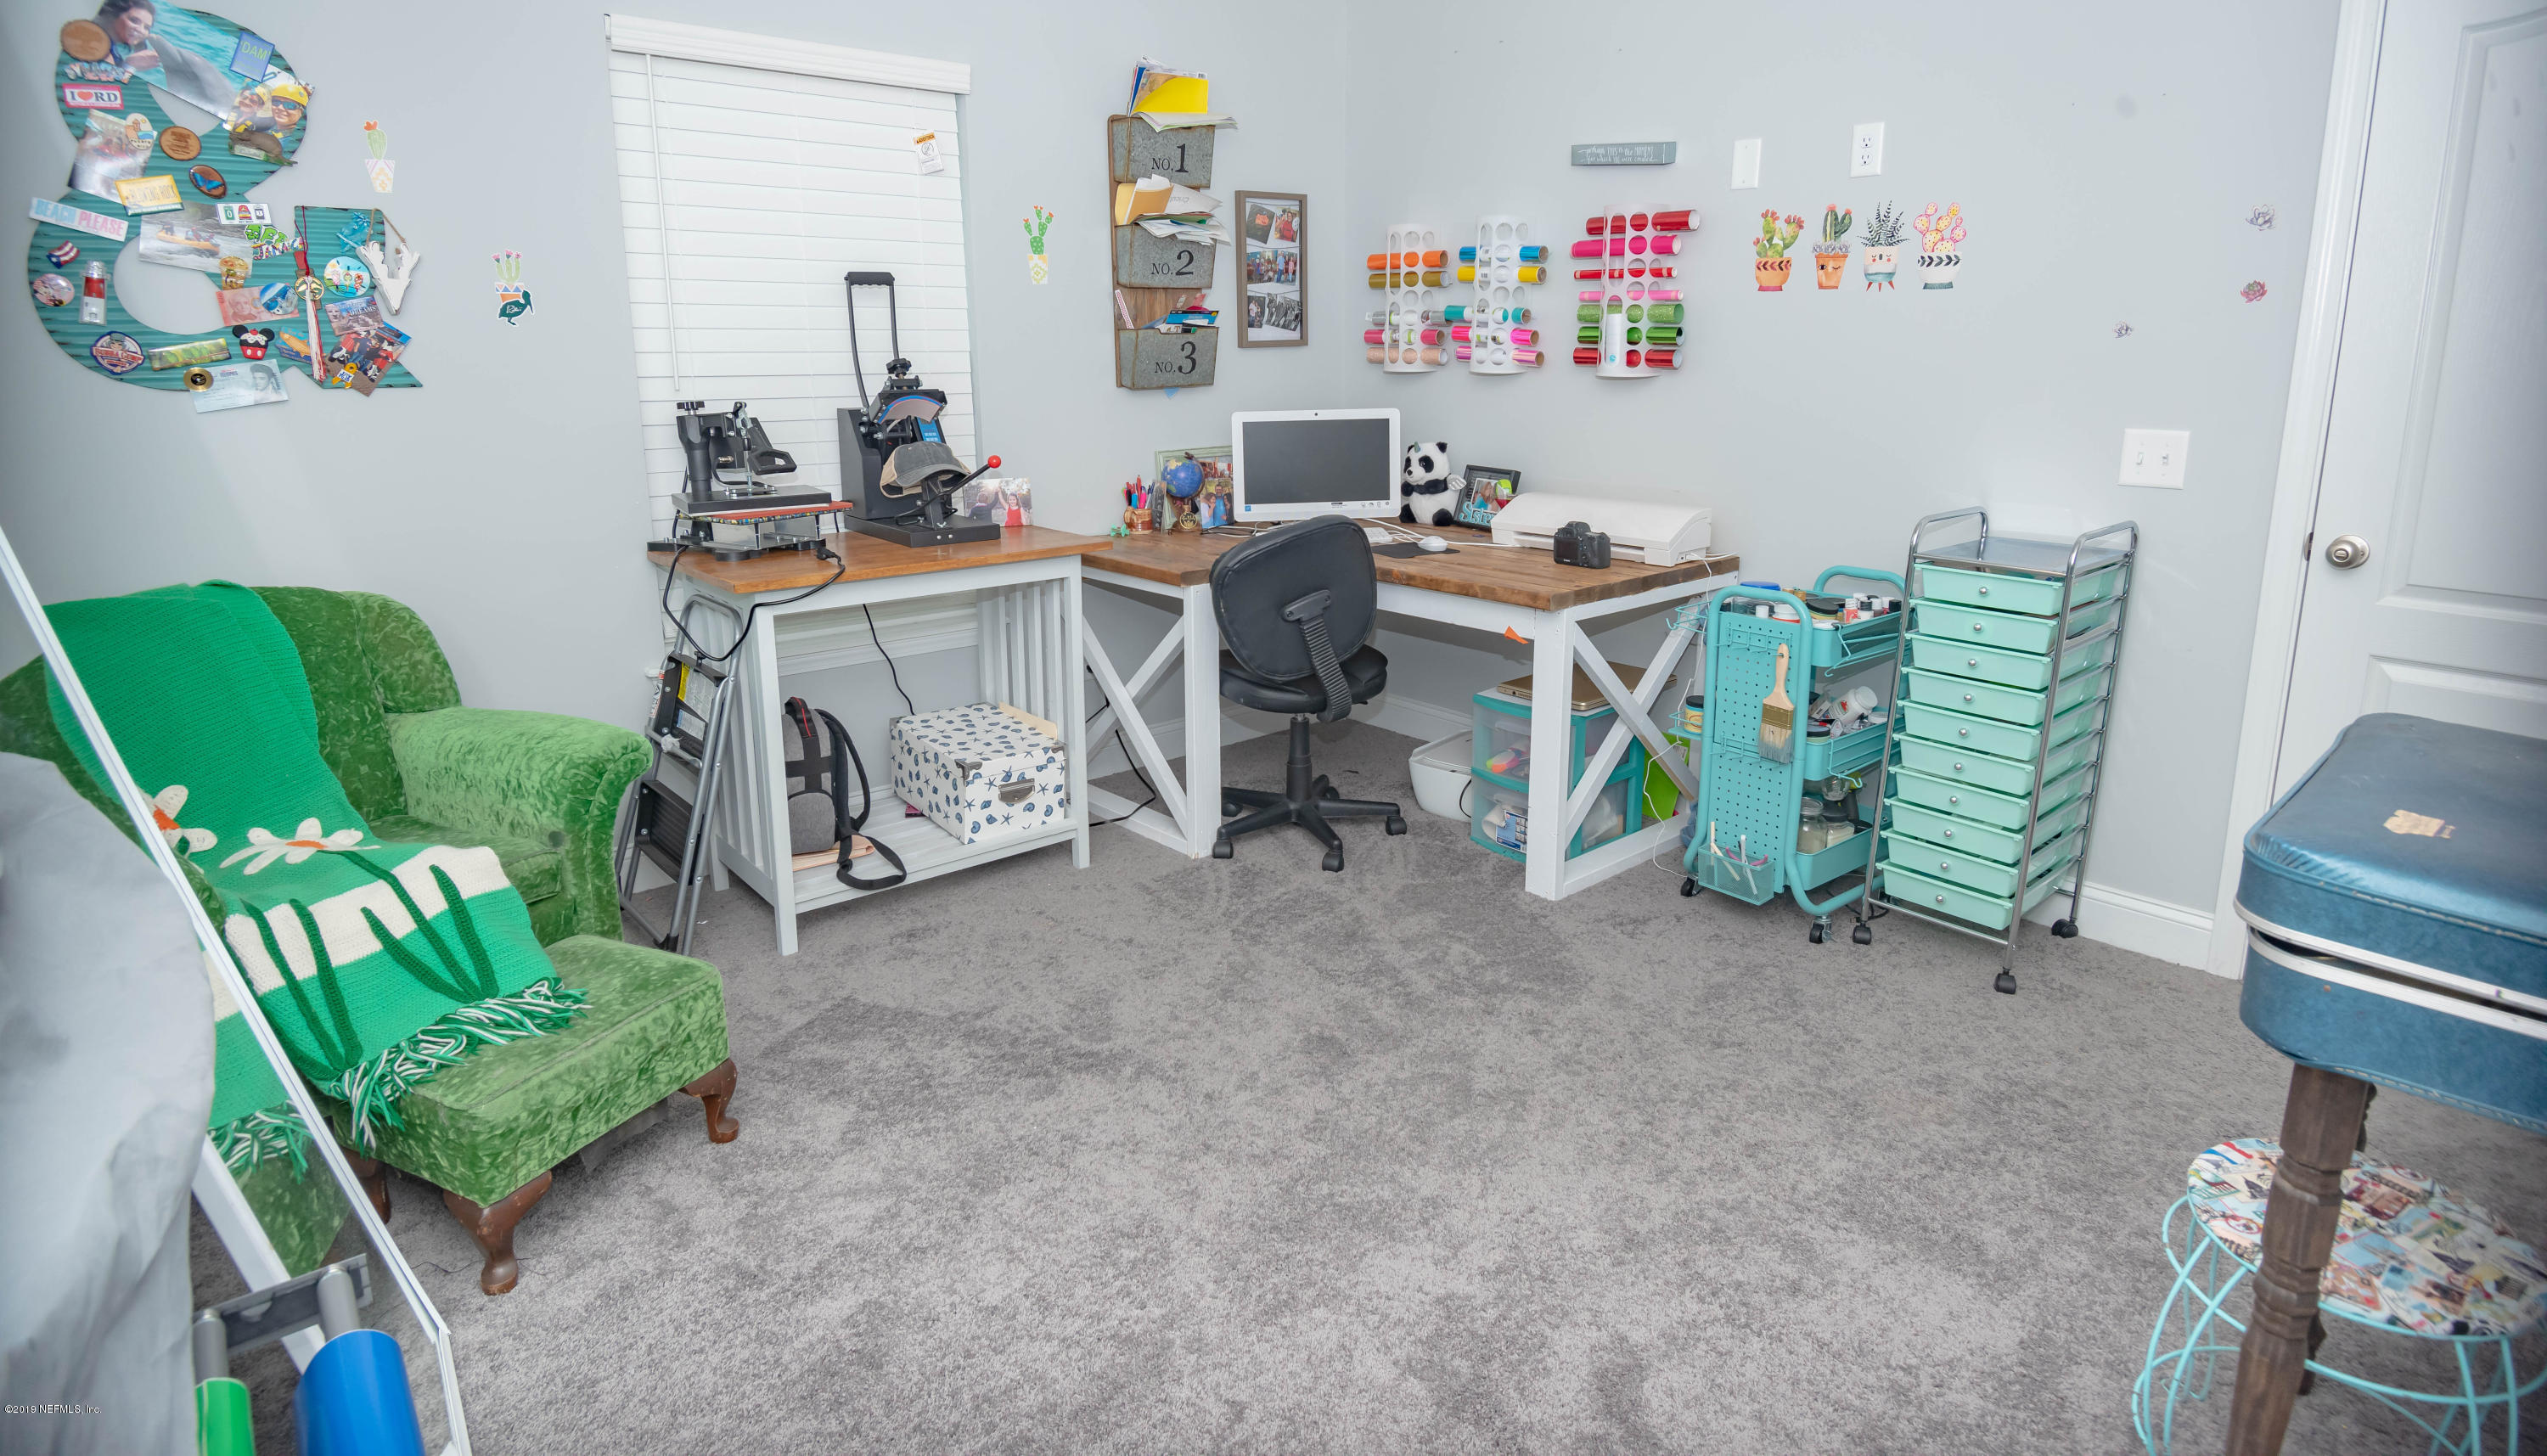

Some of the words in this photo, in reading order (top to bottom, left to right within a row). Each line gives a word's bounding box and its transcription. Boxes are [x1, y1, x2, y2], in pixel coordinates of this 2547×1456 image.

[93, 92, 118, 103] RD
[78, 211, 126, 237] PLEASE
[349, 306, 377, 317] DREAMS
